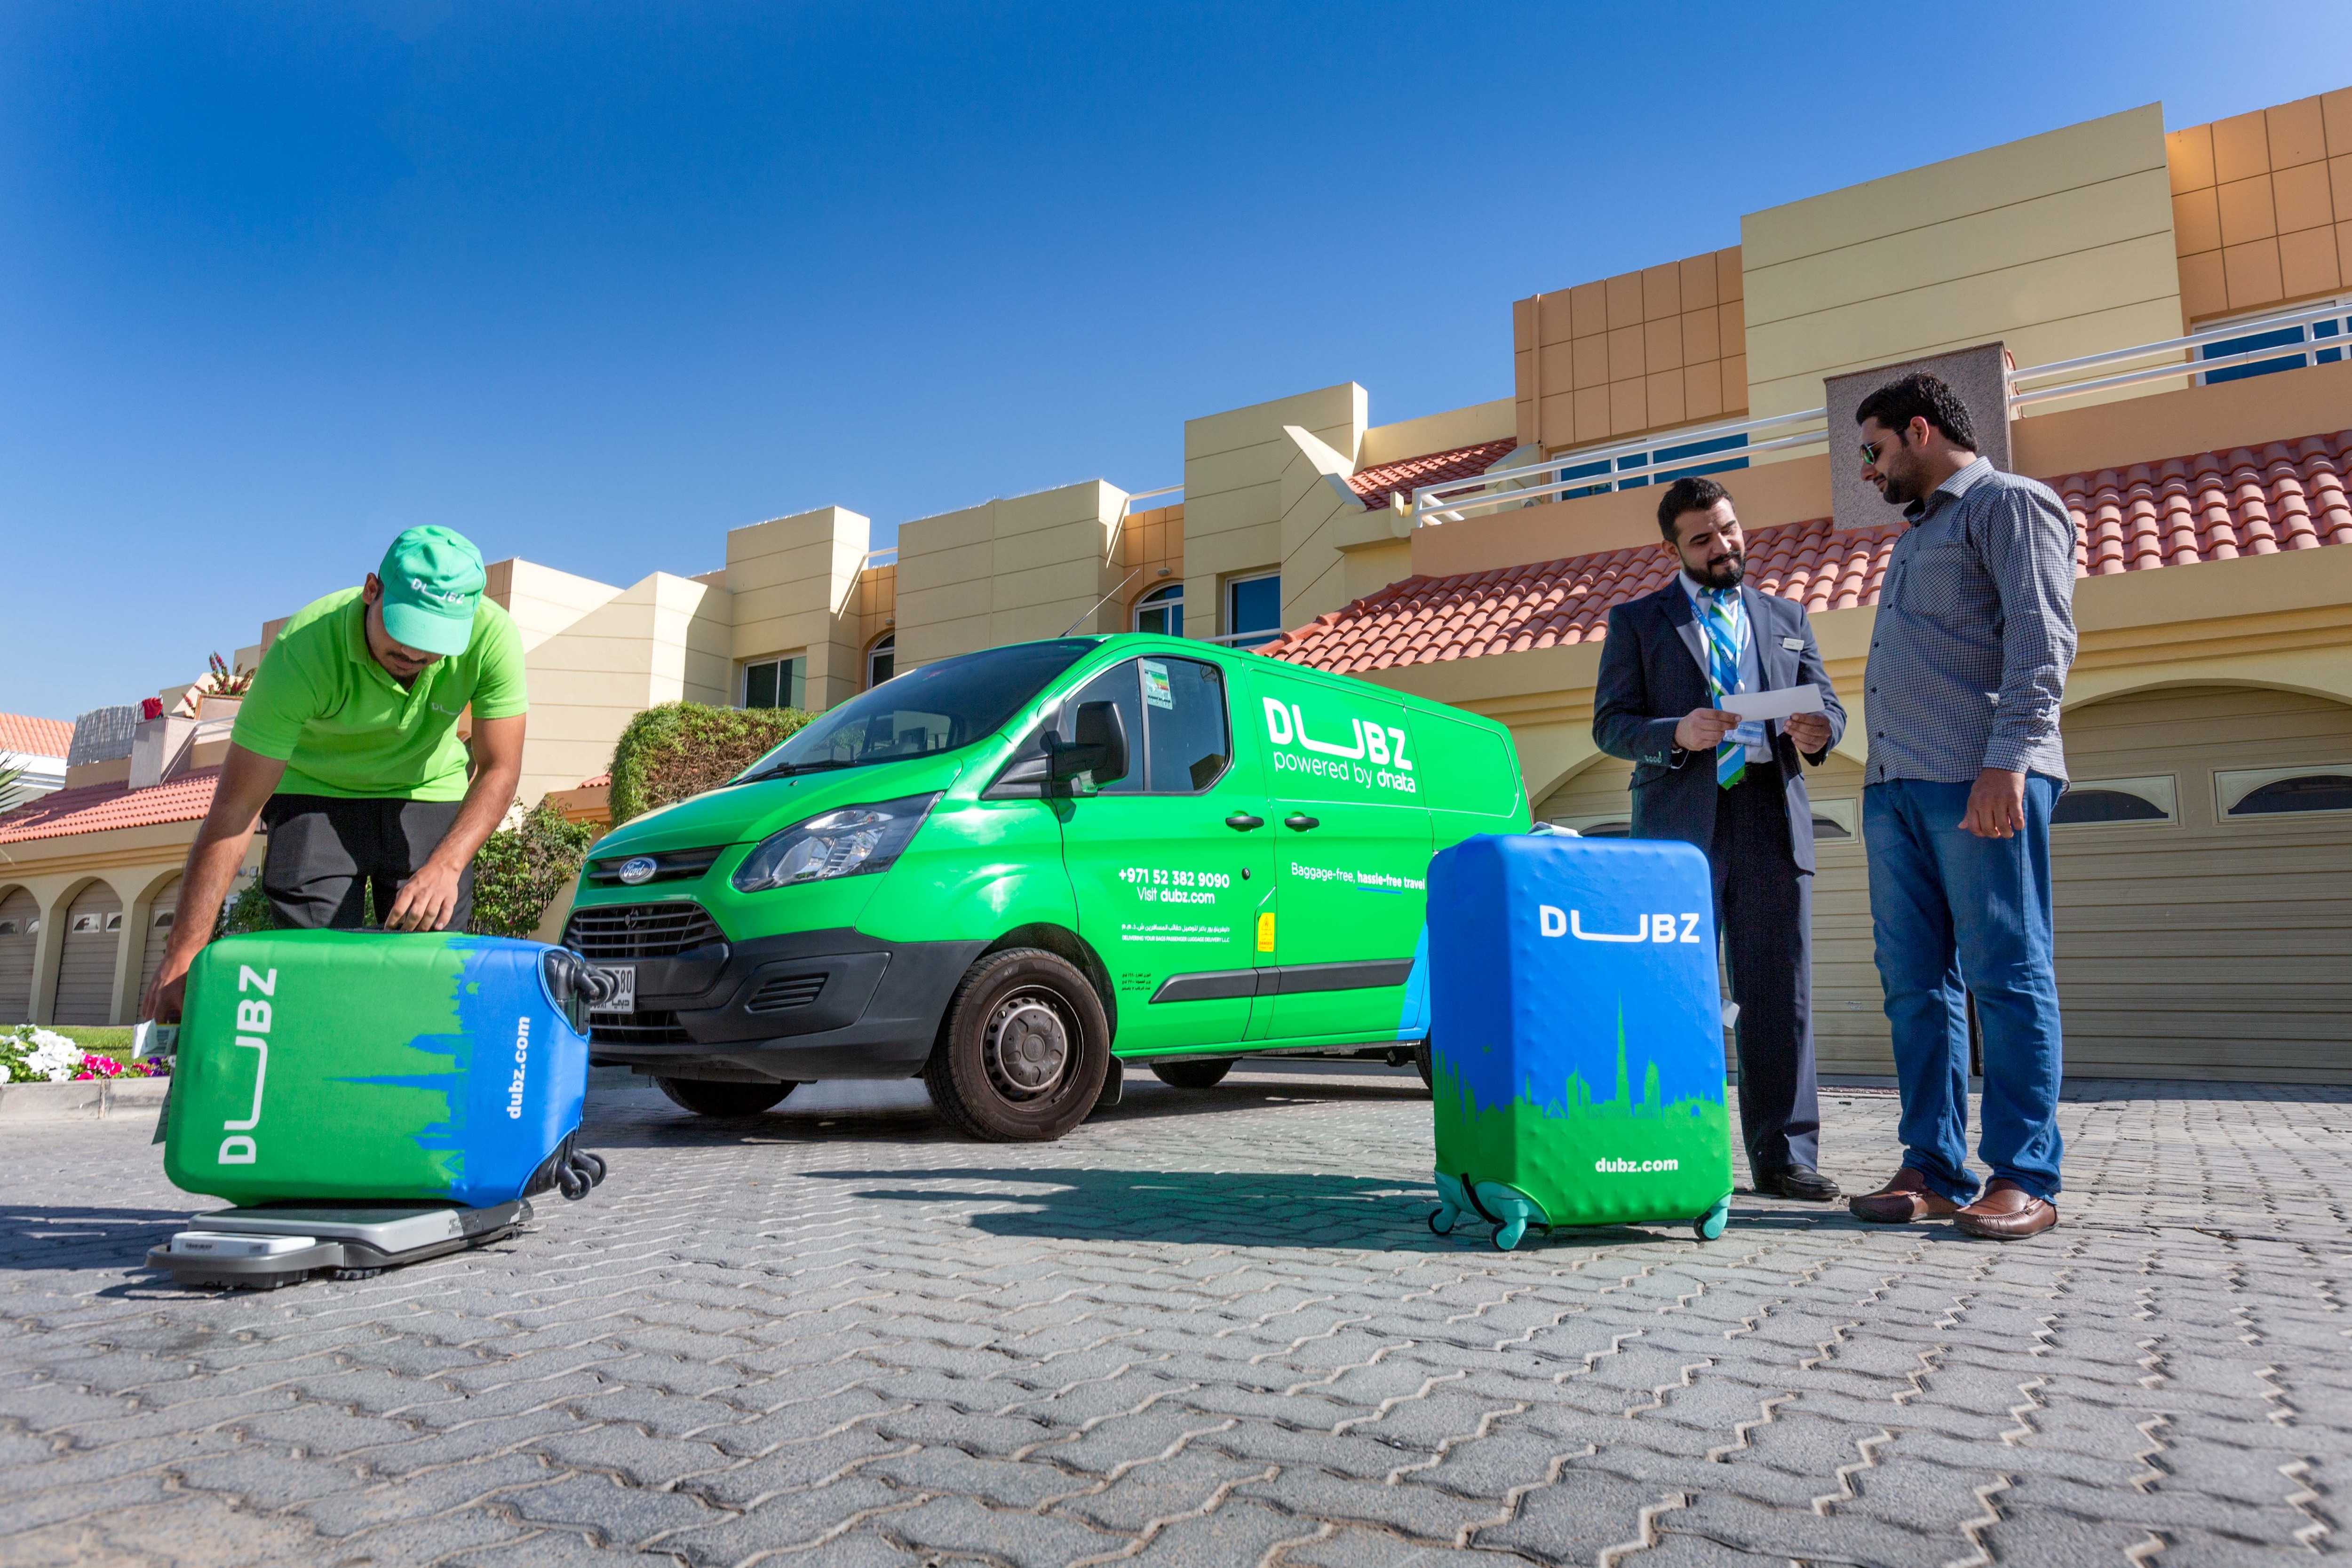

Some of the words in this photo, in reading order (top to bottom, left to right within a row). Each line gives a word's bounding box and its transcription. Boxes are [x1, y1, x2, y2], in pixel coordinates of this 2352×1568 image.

[411, 578, 465, 604] DUBZ
[1262, 696, 1413, 771] DUBZ
[1273, 751, 1349, 780] powered
[1353, 762, 1372, 788] by
[1376, 768, 1416, 793] dnata
[624, 861, 645, 877] Ford
[1119, 867, 1149, 883] +971
[1153, 869, 1168, 885] 52
[1172, 870, 1195, 886] 382
[1198, 872, 1230, 888] 9090
[1291, 862, 1355, 883] Baggage-free,
[1357, 870, 1402, 887] hassle-free
[1404, 876, 1425, 890] travel
[1136, 886, 1158, 901] Visit
[1160, 888, 1215, 904] dubz.com
[1540, 905, 1700, 943] DUBZ
[615, 970, 632, 994] 80
[612, 999, 629, 1010] دبي
[218, 965, 277, 1164] DUBZ
[506, 1017, 530, 1119] dubz.com
[1595, 1157, 1678, 1172] dubz.com
